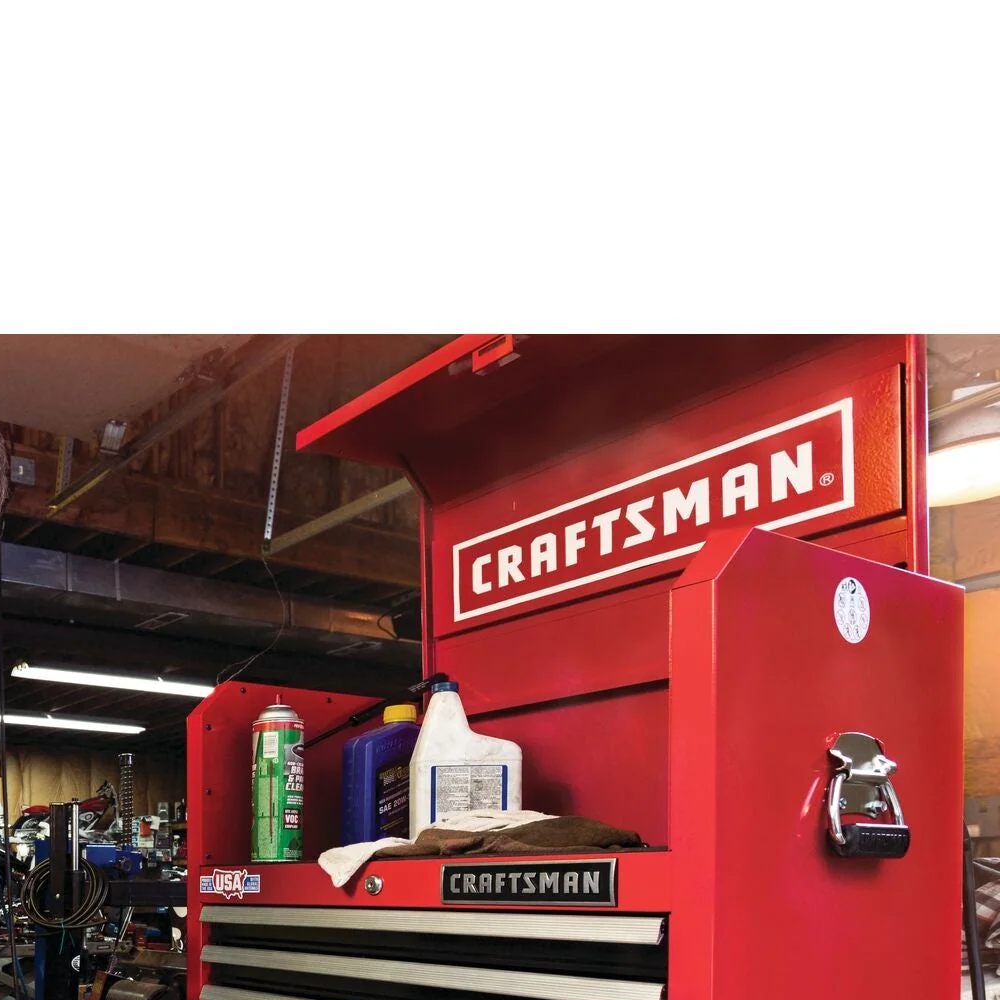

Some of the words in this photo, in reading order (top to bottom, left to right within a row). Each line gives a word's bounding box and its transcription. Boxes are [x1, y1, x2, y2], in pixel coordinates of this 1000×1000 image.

[472, 441, 813, 595] CRAFTSMAN
[379, 802, 392, 814] SAE
[285, 814, 299, 824] VOC
[215, 873, 242, 891] USA
[450, 871, 600, 894] CRAFTSMAN
